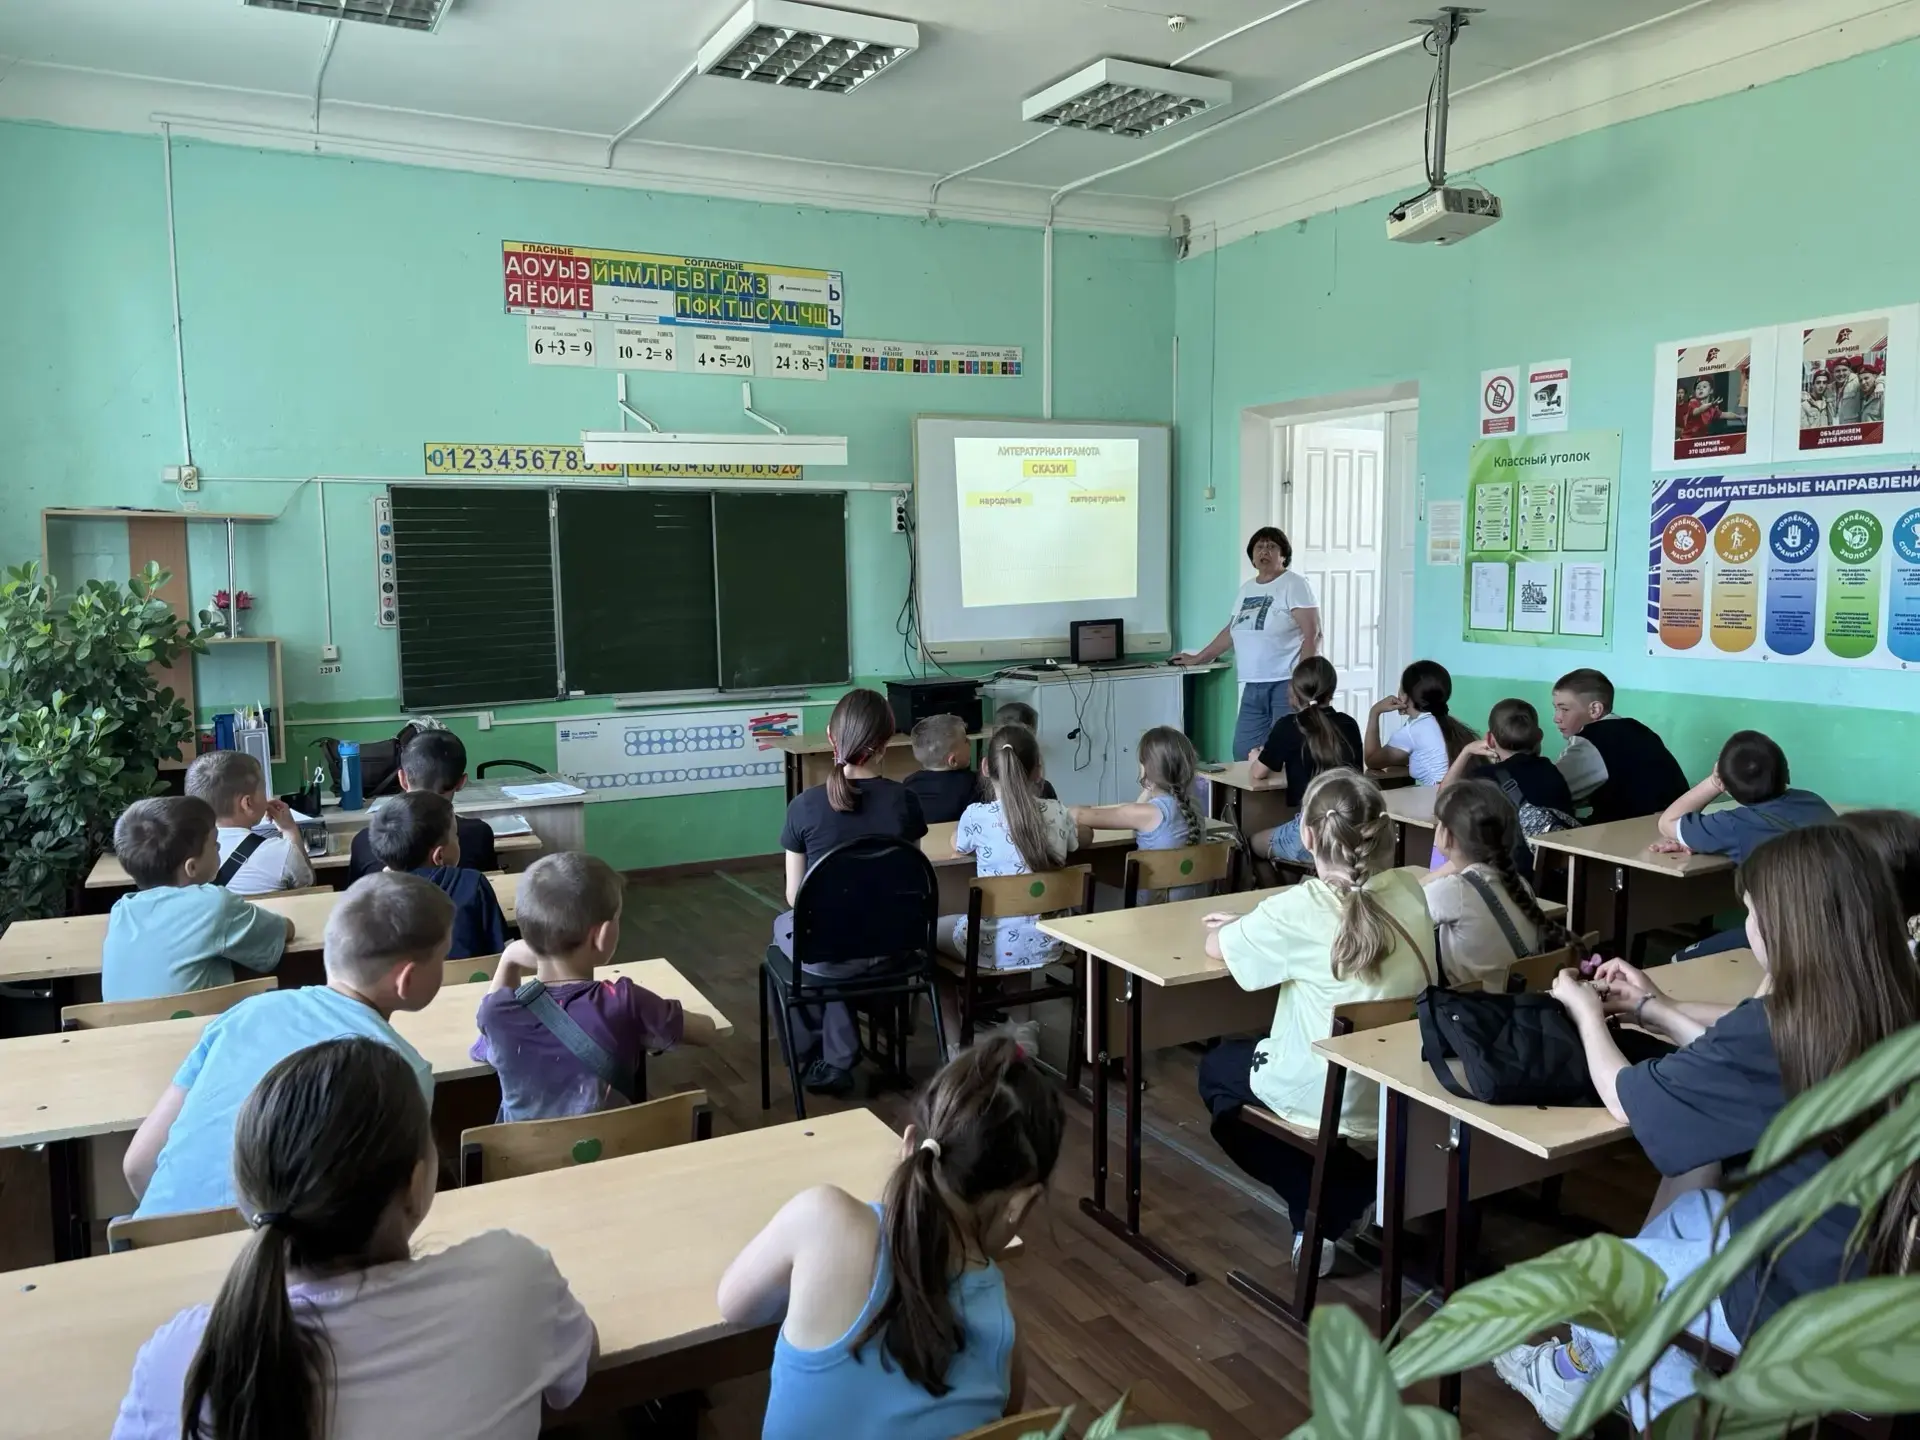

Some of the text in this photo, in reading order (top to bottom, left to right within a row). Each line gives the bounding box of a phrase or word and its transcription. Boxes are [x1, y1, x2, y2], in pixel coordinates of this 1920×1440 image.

[522, 244, 574, 255] ГЛАСНЫЕ
[684, 258, 744, 270] СОГЛАСНЫЕ
[535, 339, 543, 354] 6
[584, 341, 593, 356] 9
[619, 346, 632, 358] 10
[665, 348, 673, 360] 8
[1828, 345, 1859, 354] ЮНАРМИЯ
[698, 352, 706, 366] 4
[776, 355, 790, 370] 24
[1699, 364, 1726, 372] ЮНАРМИЯ
[1820, 428, 1861, 436] ОБЪЕДИНЯЕМ
[1818, 436, 1837, 444] ДЕТЕЙ
[998, 446, 1101, 456] ЛИТЕРАТУРНАЯ ГРАМОТА
[433, 450, 444, 467] 0
[446, 450, 456, 468] 1
[463, 449, 476, 469] 2
[480, 449, 493, 468] 3
[498, 449, 510, 469] 4
[515, 450, 528, 469] 5
[532, 450, 544, 470] 6
[548, 451, 561, 470] 7
[566, 451, 578, 470] 8
[1494, 452, 1590, 467] Классный уголок
[1032, 464, 1068, 474] СКАЗКИ
[1678, 481, 1811, 499] ВОСПИТАТЕЛЬНЫЕ
[979, 497, 1022, 506] народные
